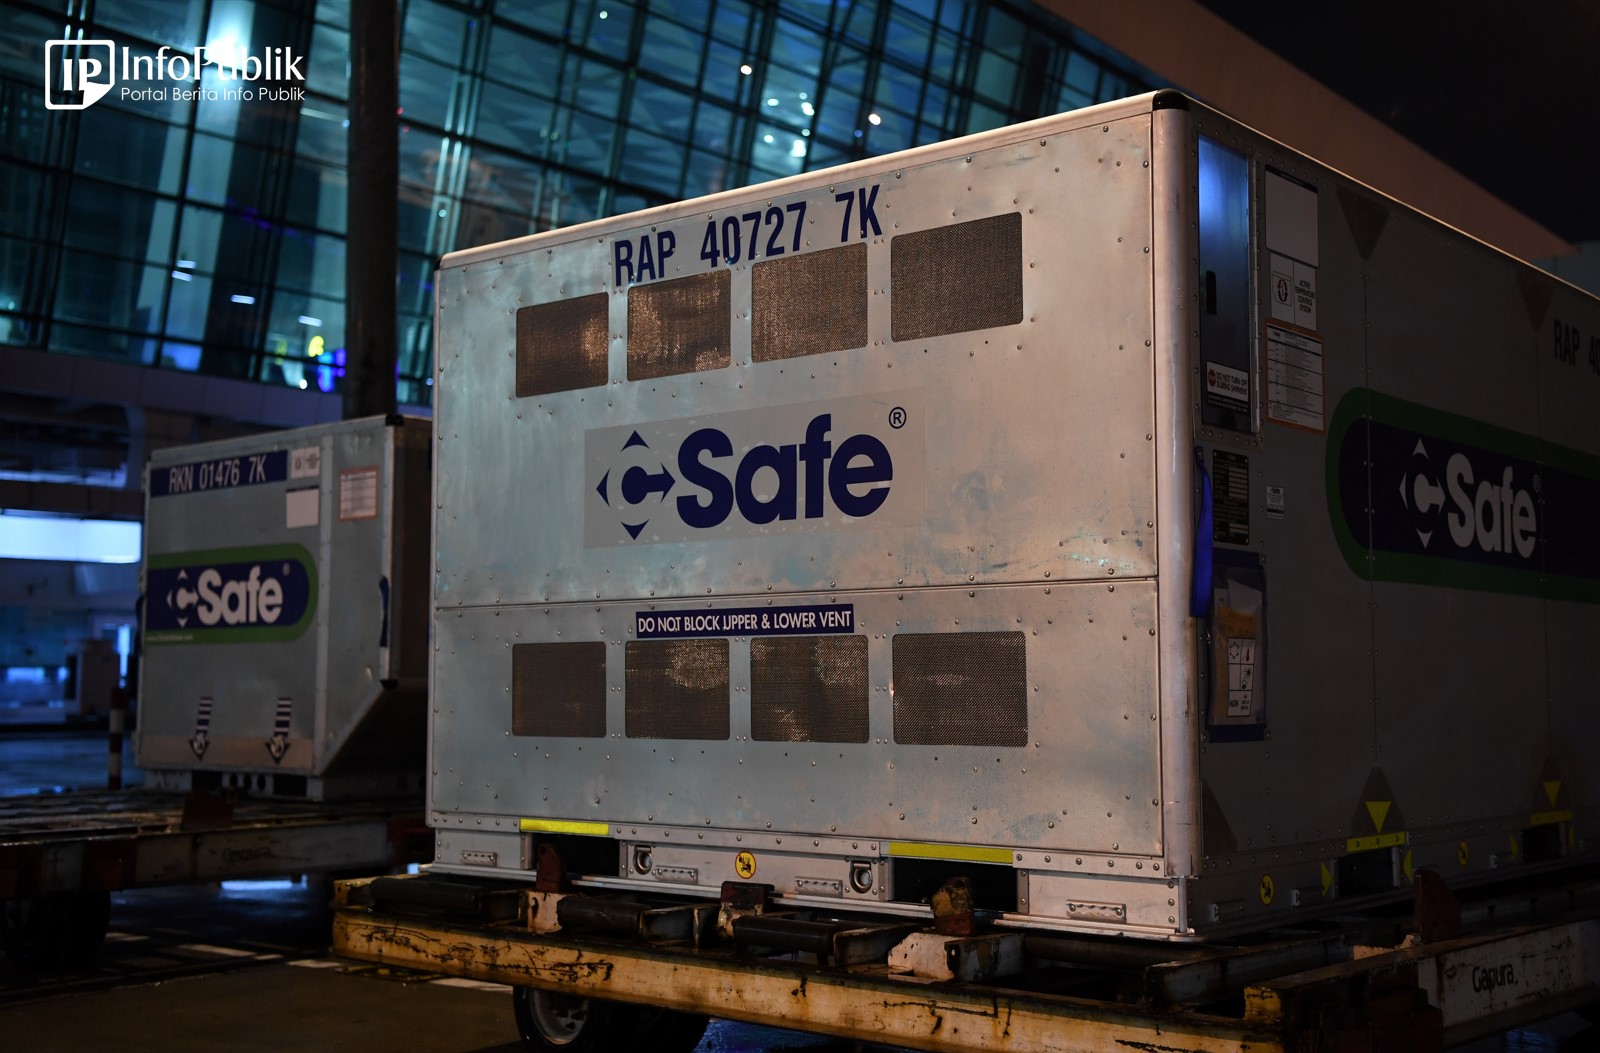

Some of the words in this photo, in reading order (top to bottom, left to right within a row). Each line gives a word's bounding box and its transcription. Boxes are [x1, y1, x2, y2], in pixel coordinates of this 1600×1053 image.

[614, 230, 676, 287] RAP
[700, 200, 807, 268] 40727
[835, 184, 883, 242] 7K
[1553, 319, 1580, 368] RAP
[1216, 372, 1222, 380] DO
[1216, 381, 1231, 391] DURING
[1231, 385, 1248, 395] SHIPMENT
[168, 465, 194, 495] RKN
[199, 459, 240, 490] 01476
[248, 455, 267, 484] 7K
[638, 616, 655, 633] DO
[658, 614, 681, 633] NOT
[684, 614, 720, 632] BLOCK
[723, 612, 758, 631] UPPER
[761, 613, 771, 629] &
[774, 611, 817, 629] LOWER
[819, 610, 851, 628] VENT
